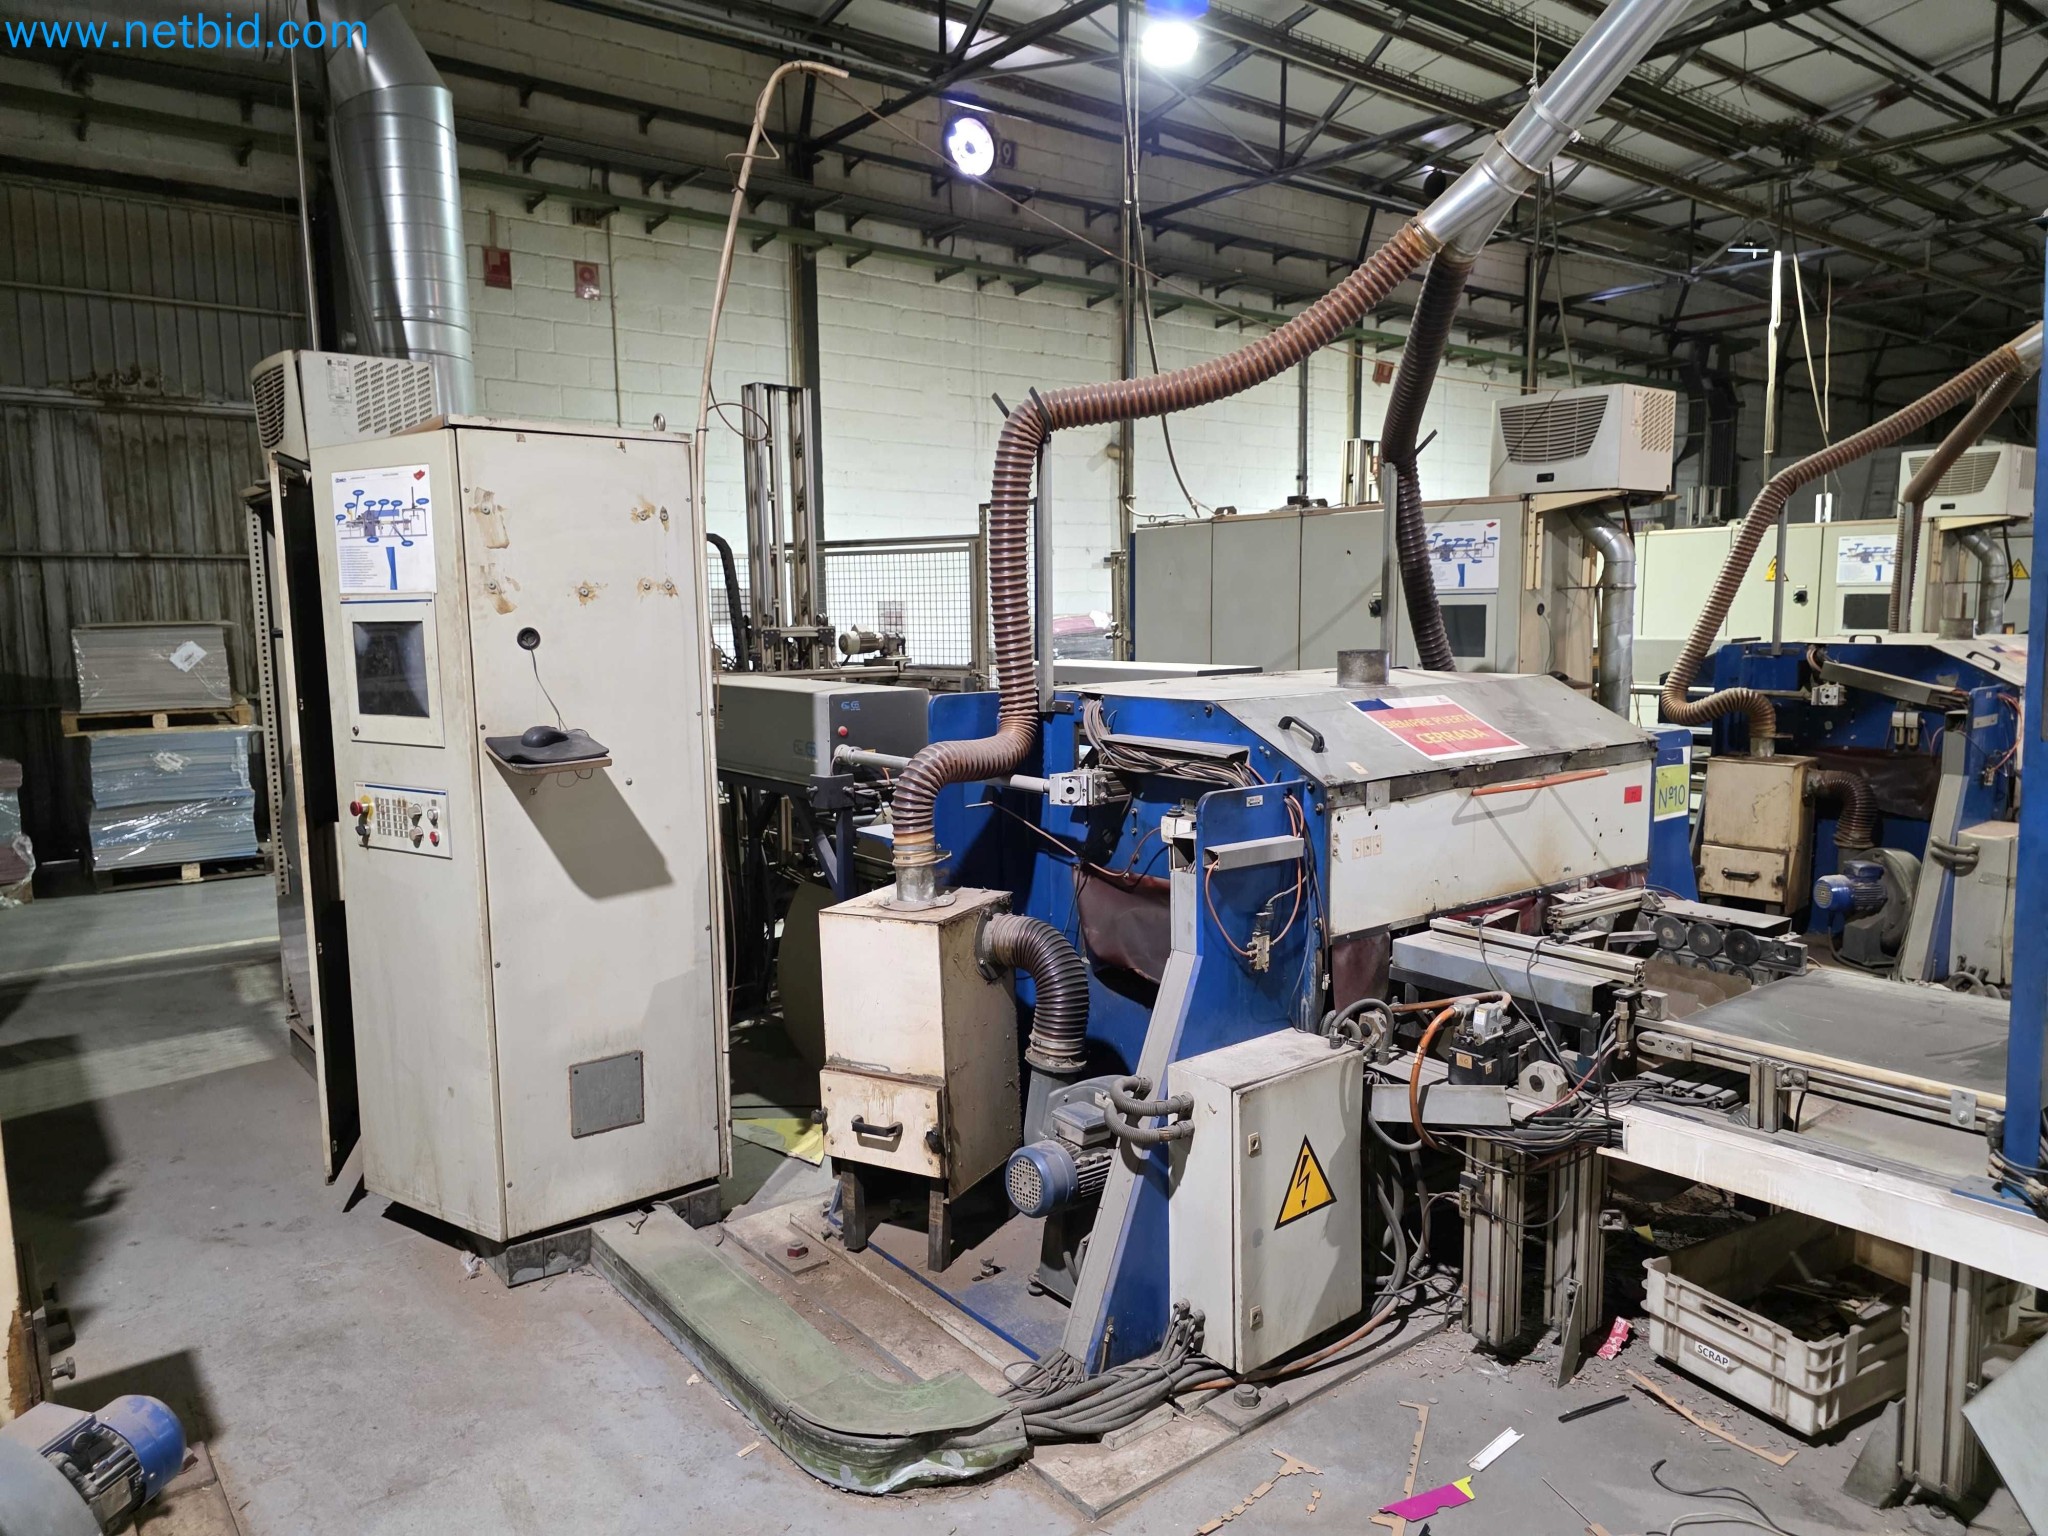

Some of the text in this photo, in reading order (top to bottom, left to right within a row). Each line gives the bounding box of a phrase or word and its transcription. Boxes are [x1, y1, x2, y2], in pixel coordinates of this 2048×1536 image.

[1381, 714, 1478, 729] SIEMPRE PUERTA
[1416, 728, 1490, 744] CERRADA
[1697, 1344, 1729, 1366] SCRAP
